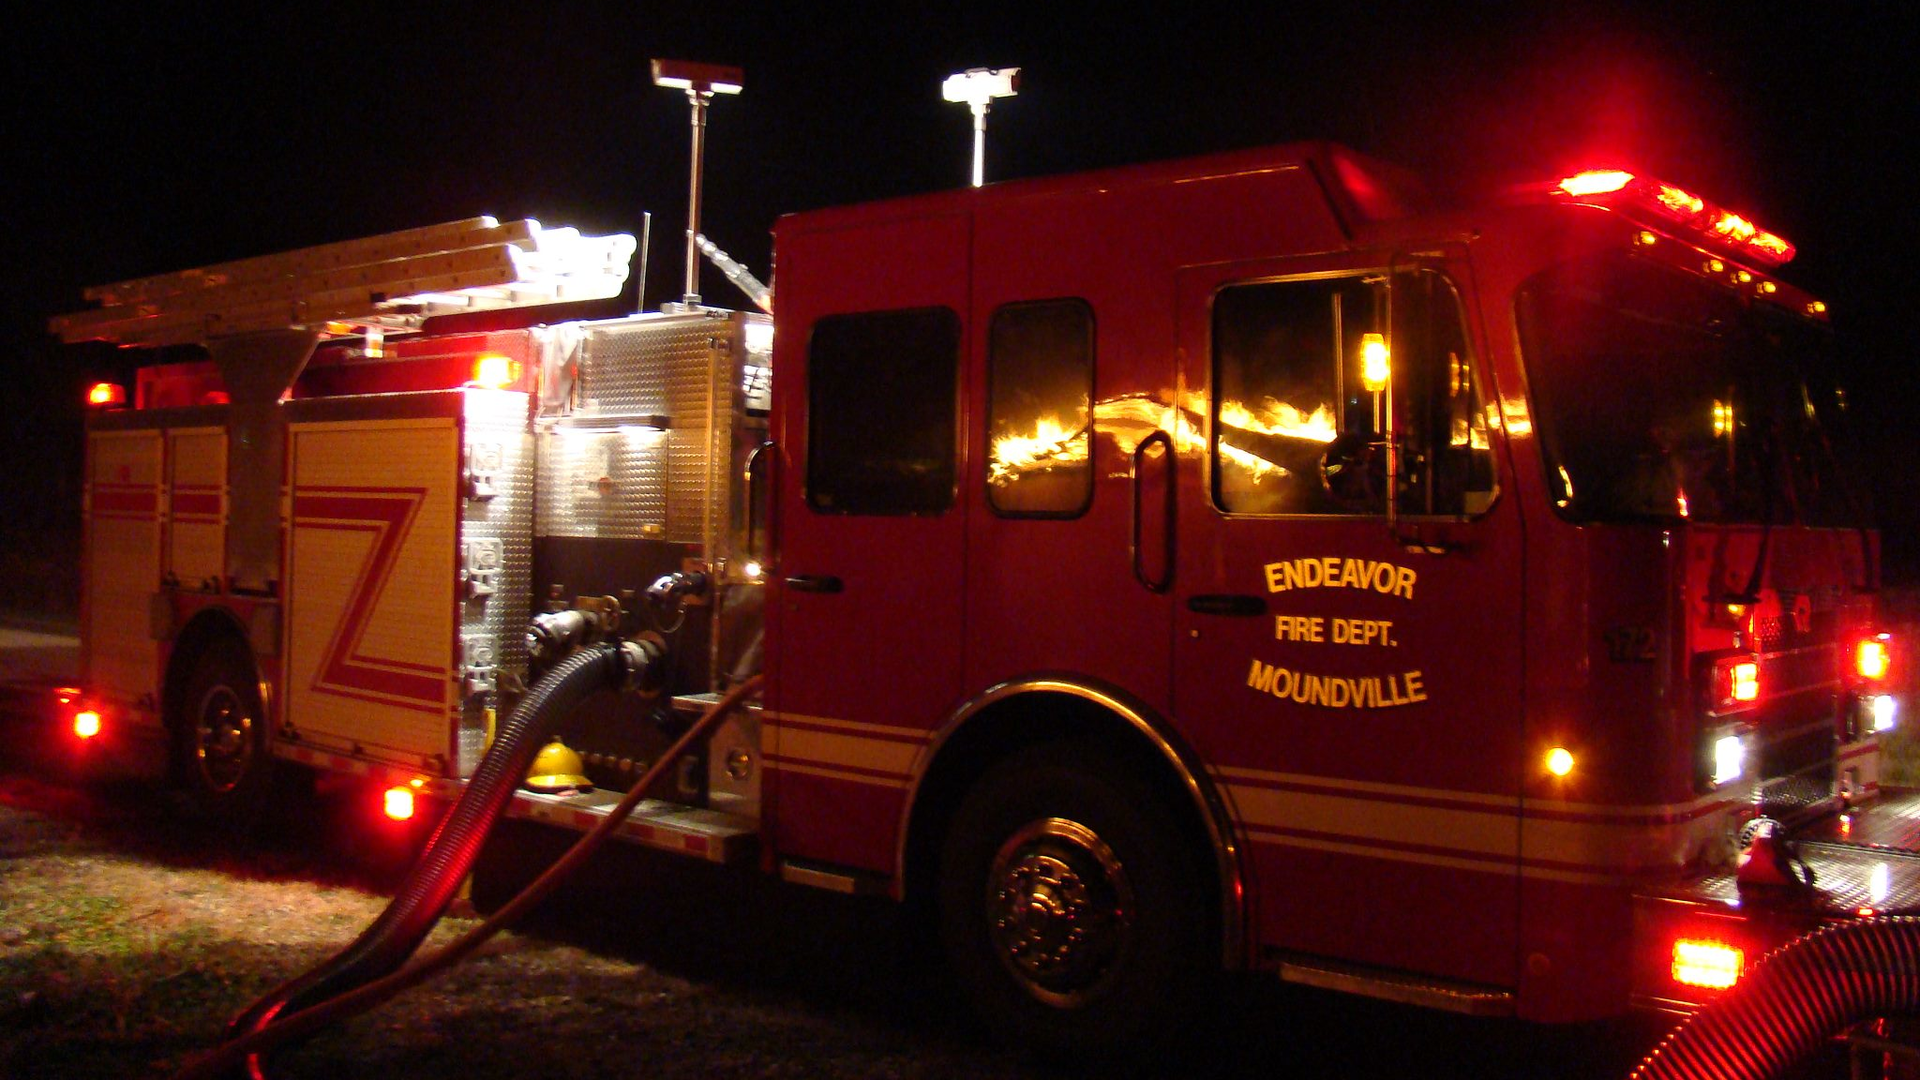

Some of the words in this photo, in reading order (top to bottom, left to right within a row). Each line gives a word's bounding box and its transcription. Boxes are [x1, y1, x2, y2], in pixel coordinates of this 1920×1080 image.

[1264, 557, 1417, 599] ENDEAVOR
[1275, 615, 1324, 643] FIRE
[1332, 618, 1398, 647] DEPT.
[1247, 659, 1428, 708] MOUNDVILLE
